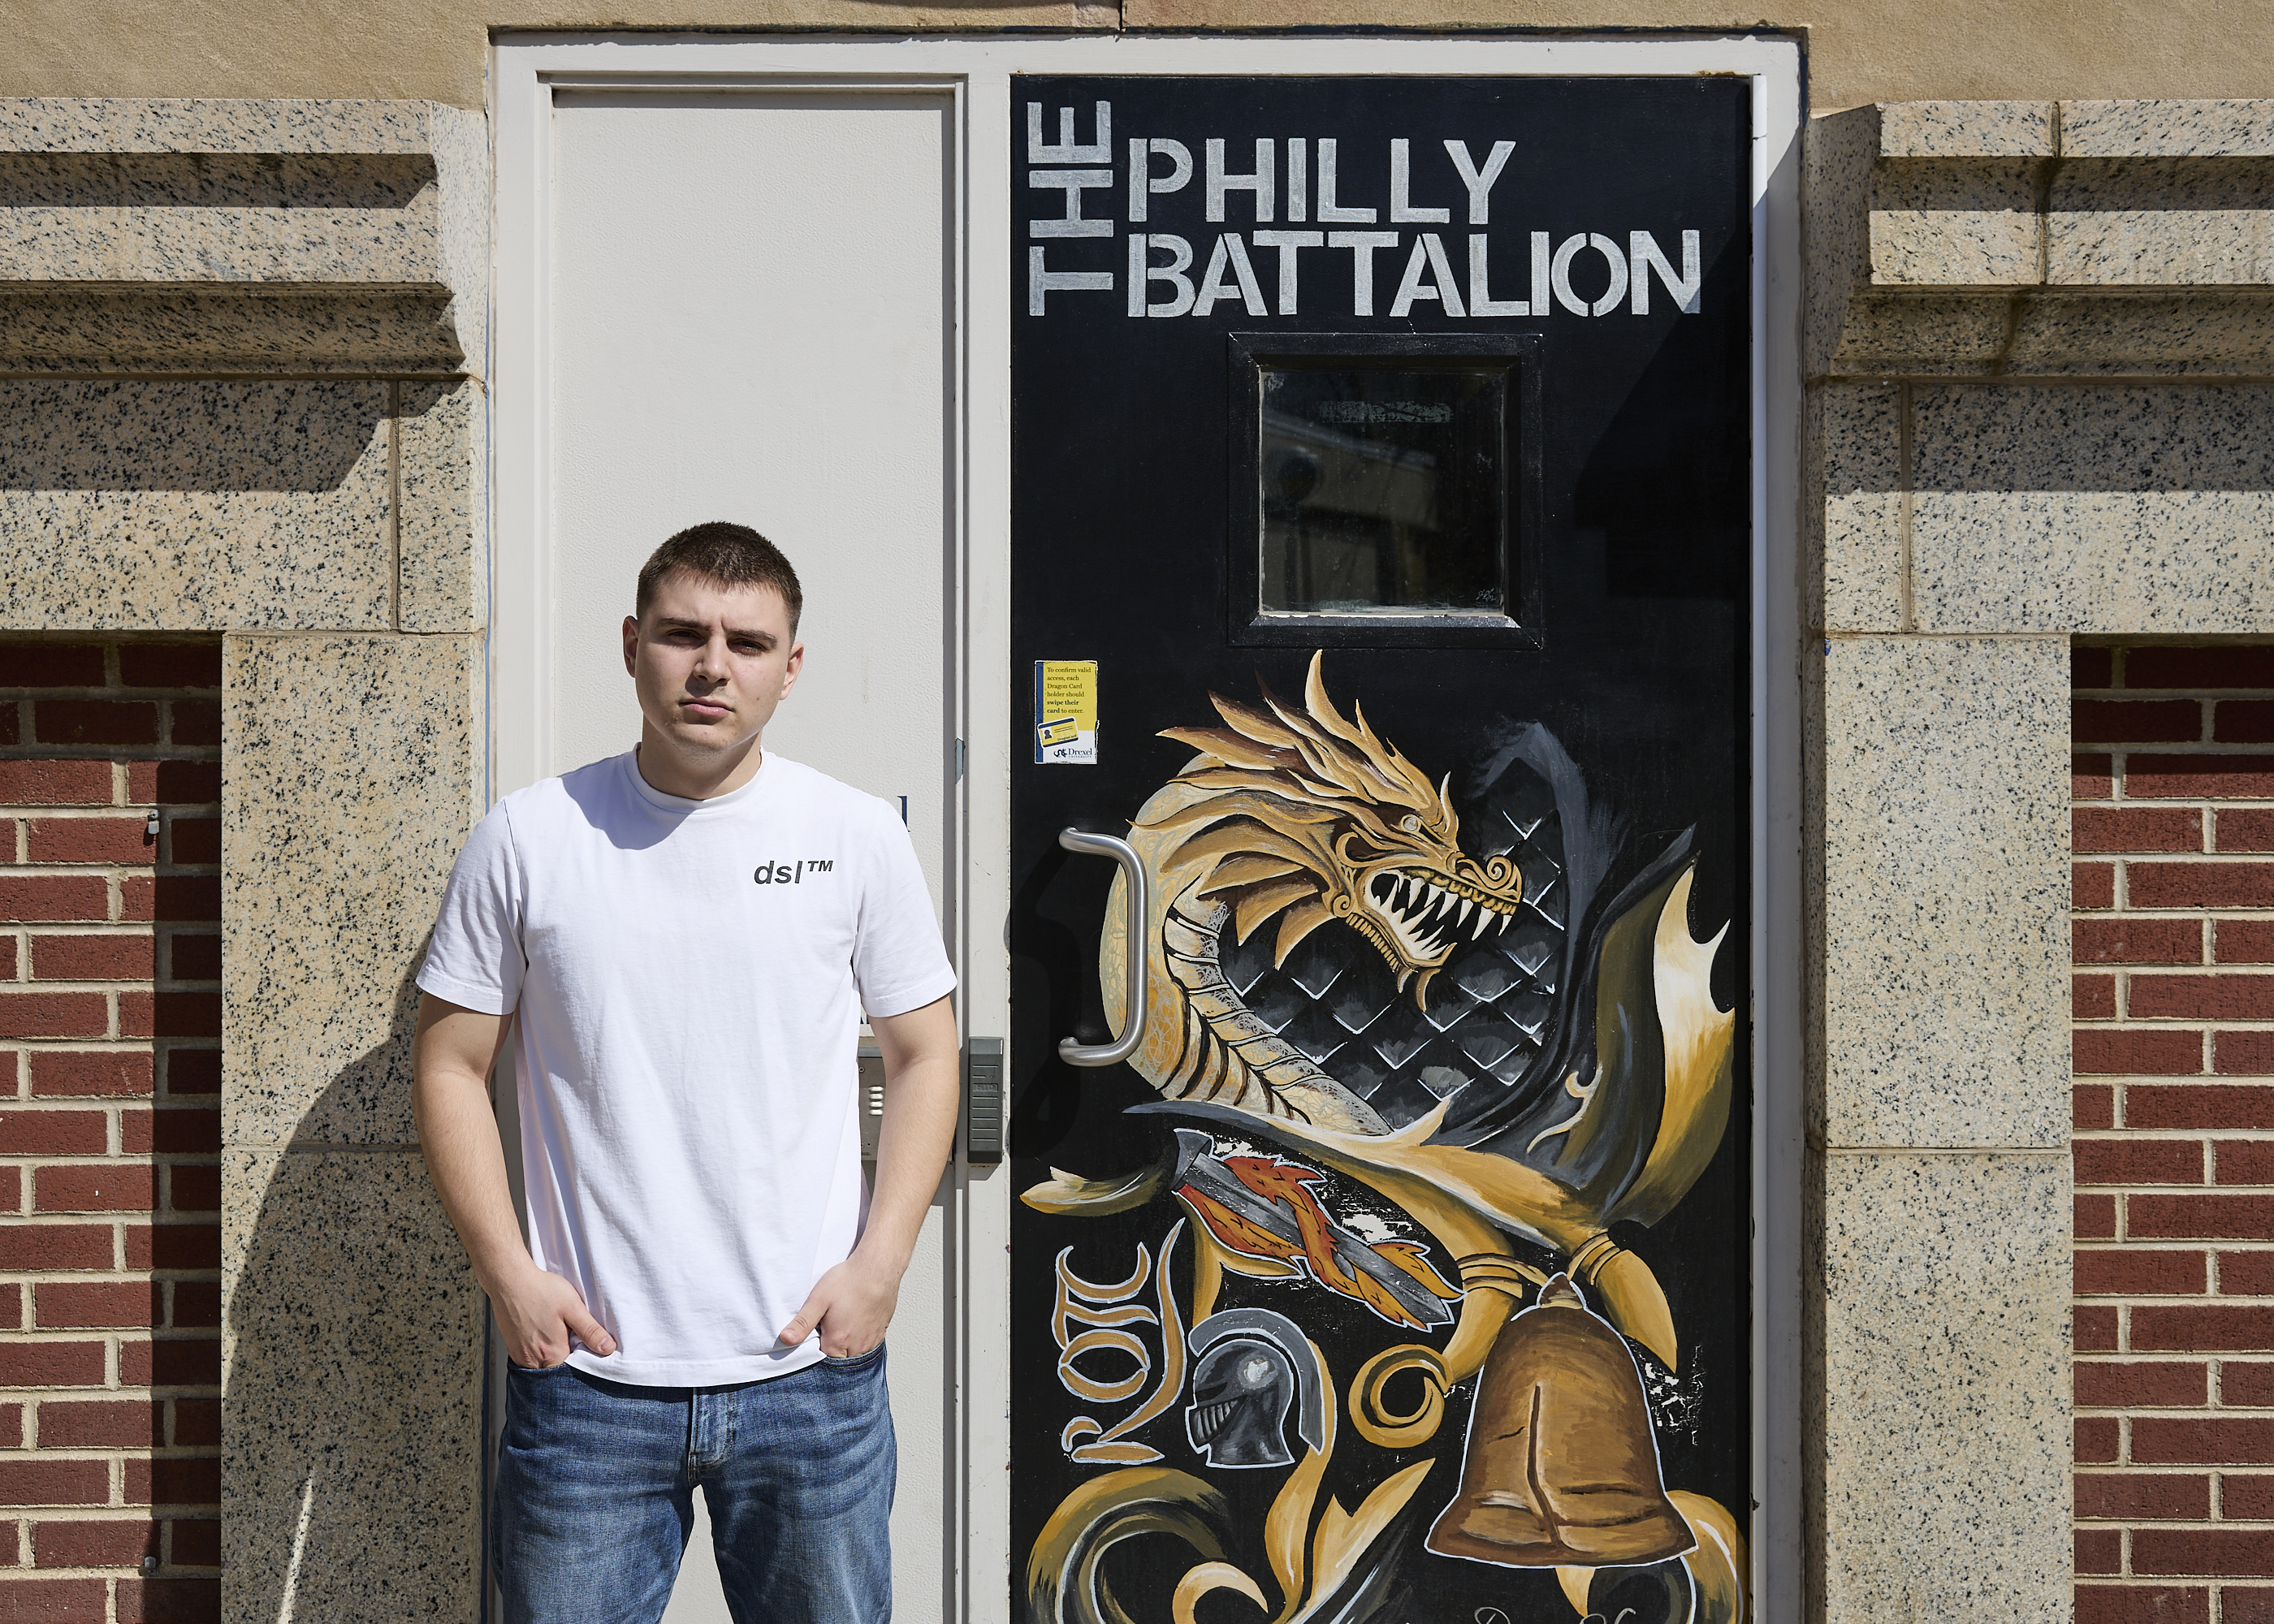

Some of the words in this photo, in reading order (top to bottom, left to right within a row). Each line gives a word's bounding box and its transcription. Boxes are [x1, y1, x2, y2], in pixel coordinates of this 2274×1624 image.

[1027, 101, 1114, 317] THE
[1128, 138, 1517, 225] PHILLY
[1127, 229, 1701, 317] BATTALION
[1052, 1217, 1187, 1465] ROTC
